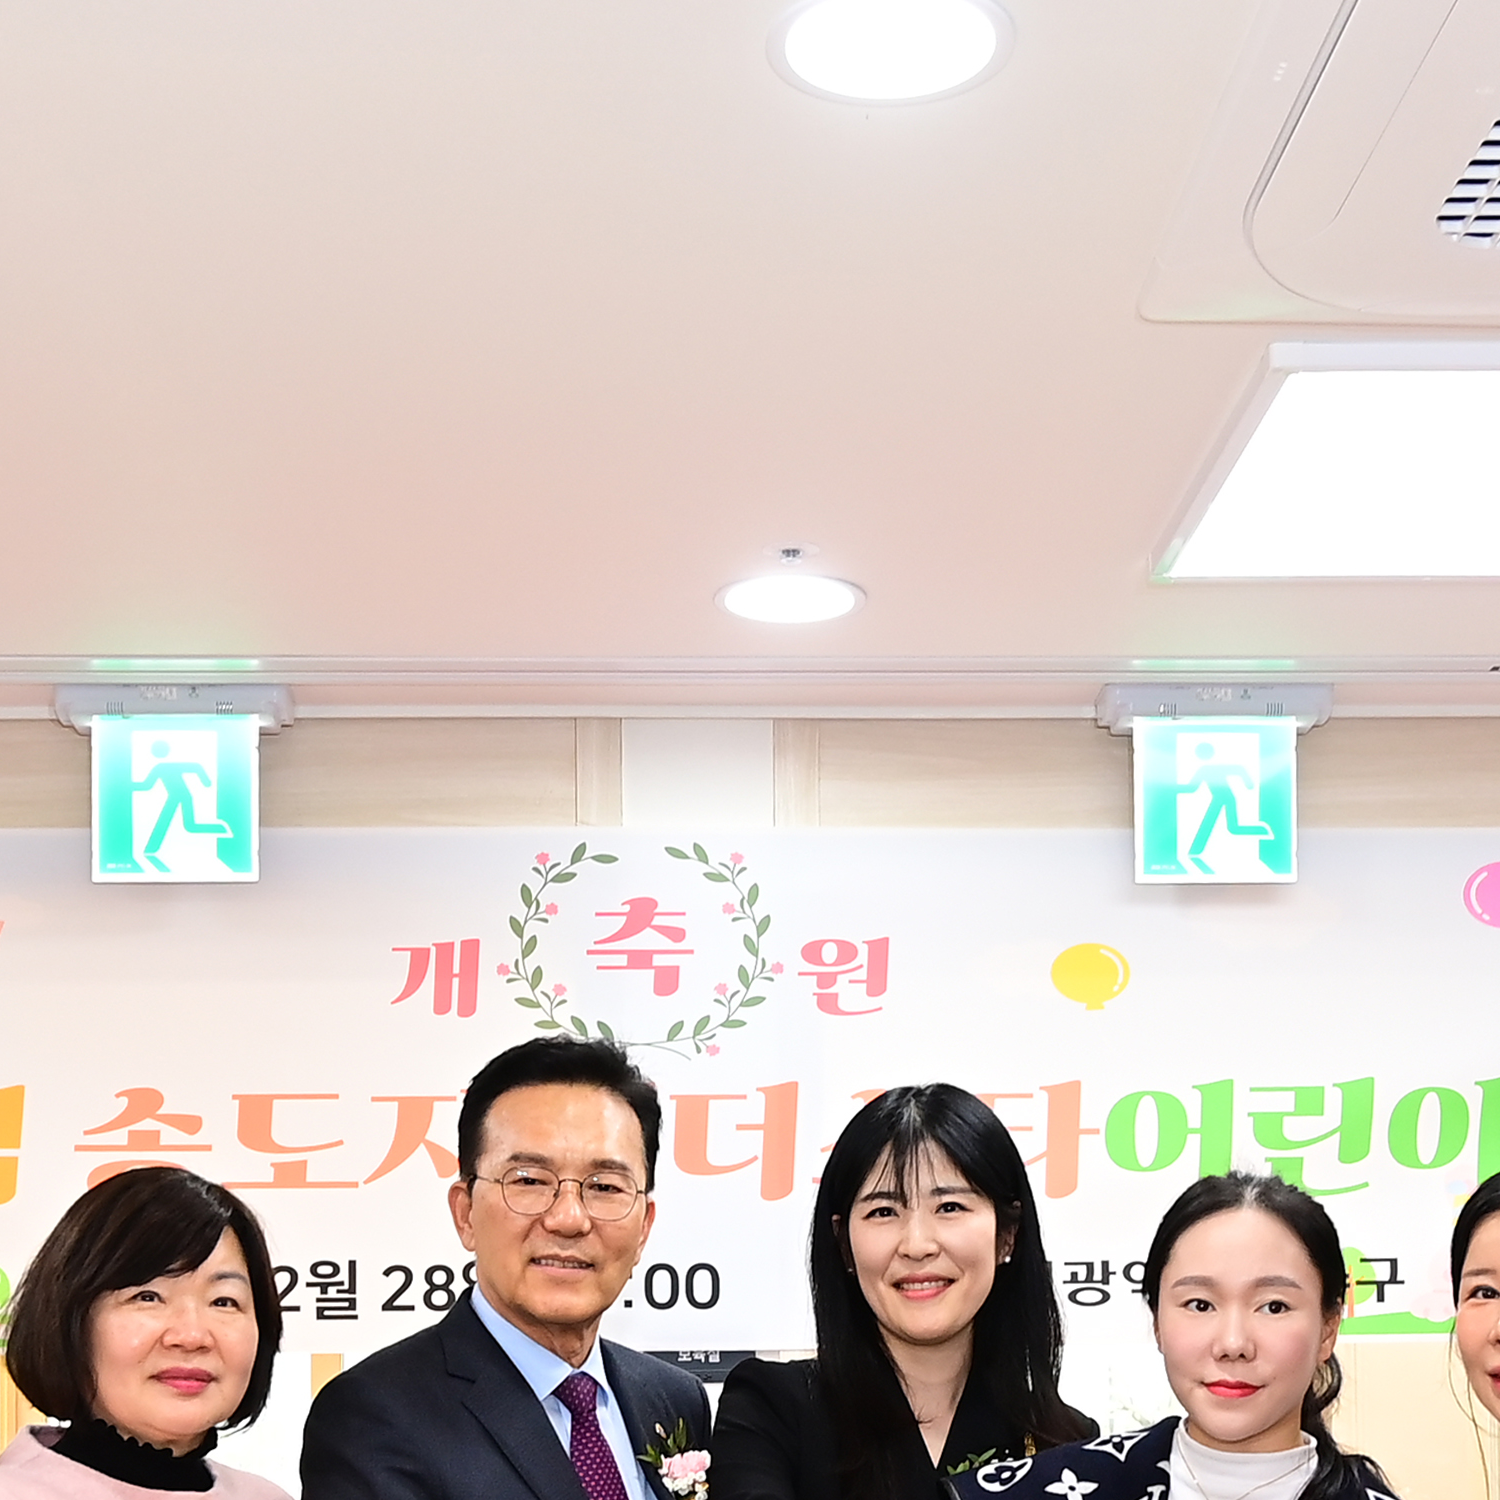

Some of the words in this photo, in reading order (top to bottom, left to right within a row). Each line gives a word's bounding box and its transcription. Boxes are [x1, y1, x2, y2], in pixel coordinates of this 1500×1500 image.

[390, 938, 481, 1018] 개
[586, 896, 695, 997] 축
[798, 936, 890, 1016] 원
[1345, 1258, 1405, 1303] 구
